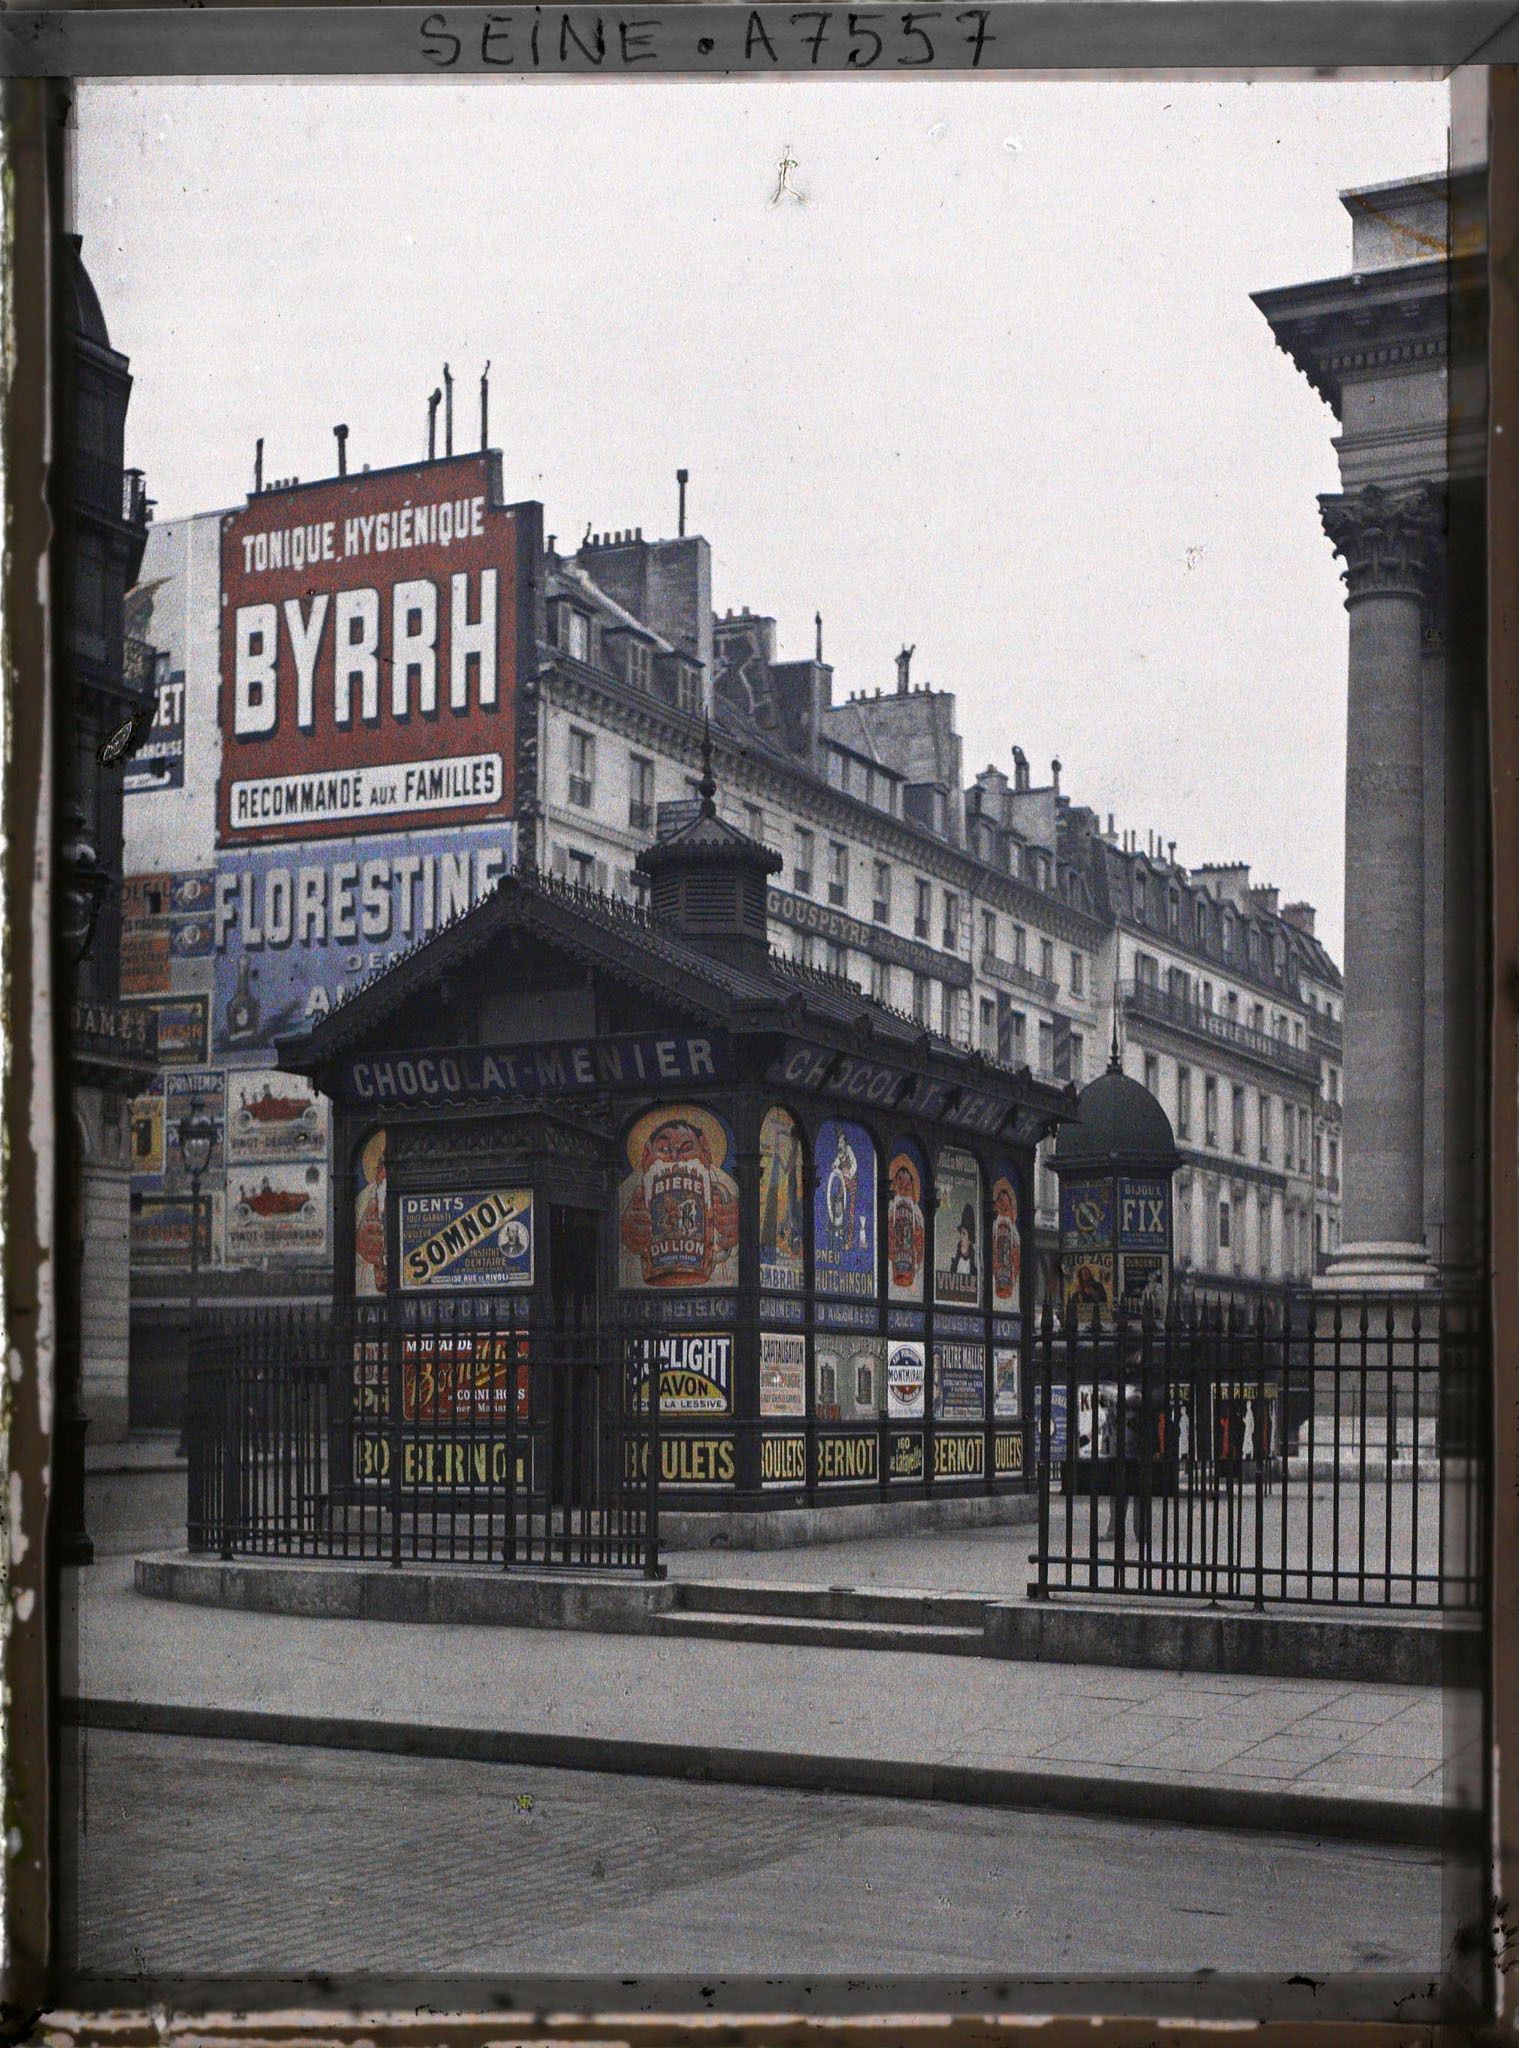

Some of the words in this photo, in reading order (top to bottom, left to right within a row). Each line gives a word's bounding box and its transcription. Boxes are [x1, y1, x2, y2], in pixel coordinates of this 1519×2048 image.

[420, 7, 663, 66] SEINE
[744, 10, 997, 68] A7557
[345, 496, 485, 558] HYGIÉNIQUE
[234, 569, 498, 737] BYRRH
[370, 786, 397, 807] AUX
[404, 760, 496, 804] FAMILLES
[407, 1197, 464, 1213] DENTS
[1121, 1199, 1165, 1232] FIX
[409, 1194, 515, 1279] SOMNOL
[660, 1376, 709, 1396] AVON
[681, 1400, 724, 1409] LESSIVE
